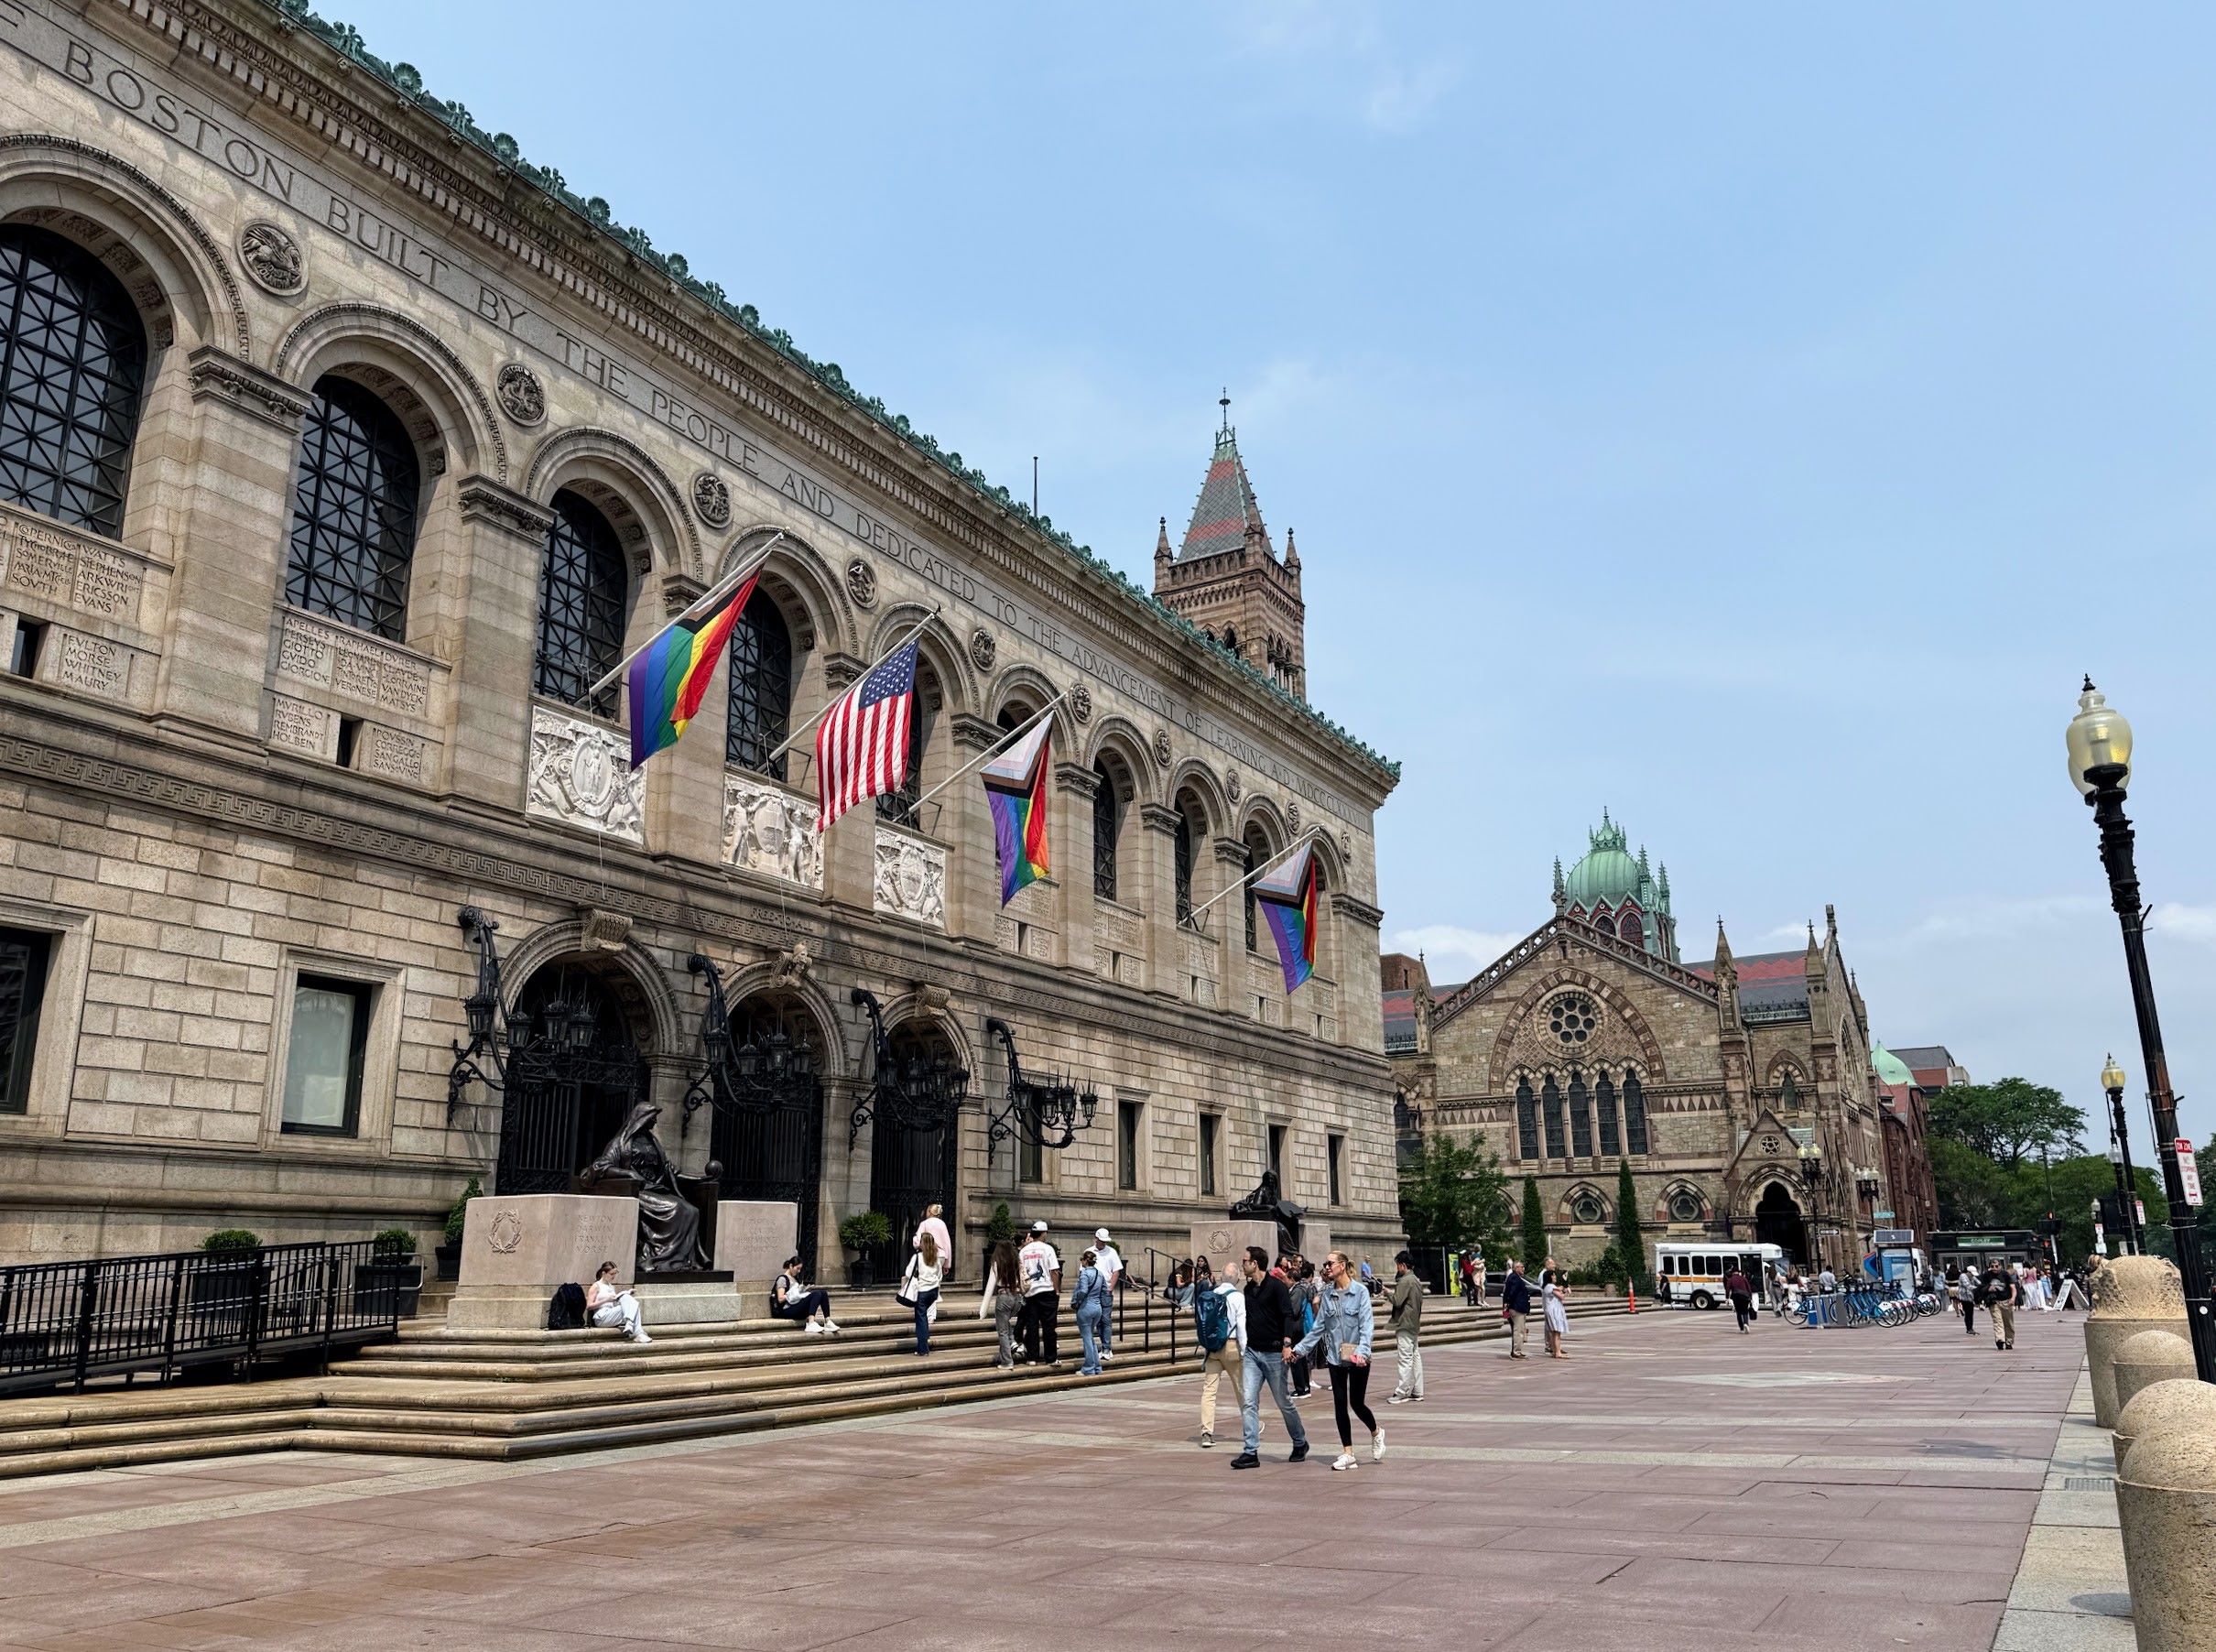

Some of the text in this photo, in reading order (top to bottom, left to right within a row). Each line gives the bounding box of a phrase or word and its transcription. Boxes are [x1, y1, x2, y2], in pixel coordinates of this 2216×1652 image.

[65, 40, 295, 203] BOSTON
[327, 195, 450, 287] BUILT
[477, 284, 527, 331] BY
[556, 331, 630, 399] THE
[651, 388, 760, 476] PEOPLE
[780, 472, 834, 518] AND
[856, 513, 976, 602] DEDICATED
[993, 595, 1017, 626] TO
[1027, 616, 1062, 656] THE
[1071, 646, 1176, 719] ADVANCEMENT
[1185, 711, 1202, 733] OF
[1210, 724, 1266, 772] LEARNING
[74, 592, 112, 614] EVANS
[76, 581, 129, 605] ERICSSON
[286, 618, 330, 640] APELLES
[339, 636, 380, 657] RAPHAEL
[66, 647, 111, 668] MORSE
[62, 670, 109, 690] MAURY
[65, 658, 122, 683] WHITNEY
[273, 730, 315, 751] HOLBEIN
[275, 720, 323, 740] REMBRANDT
